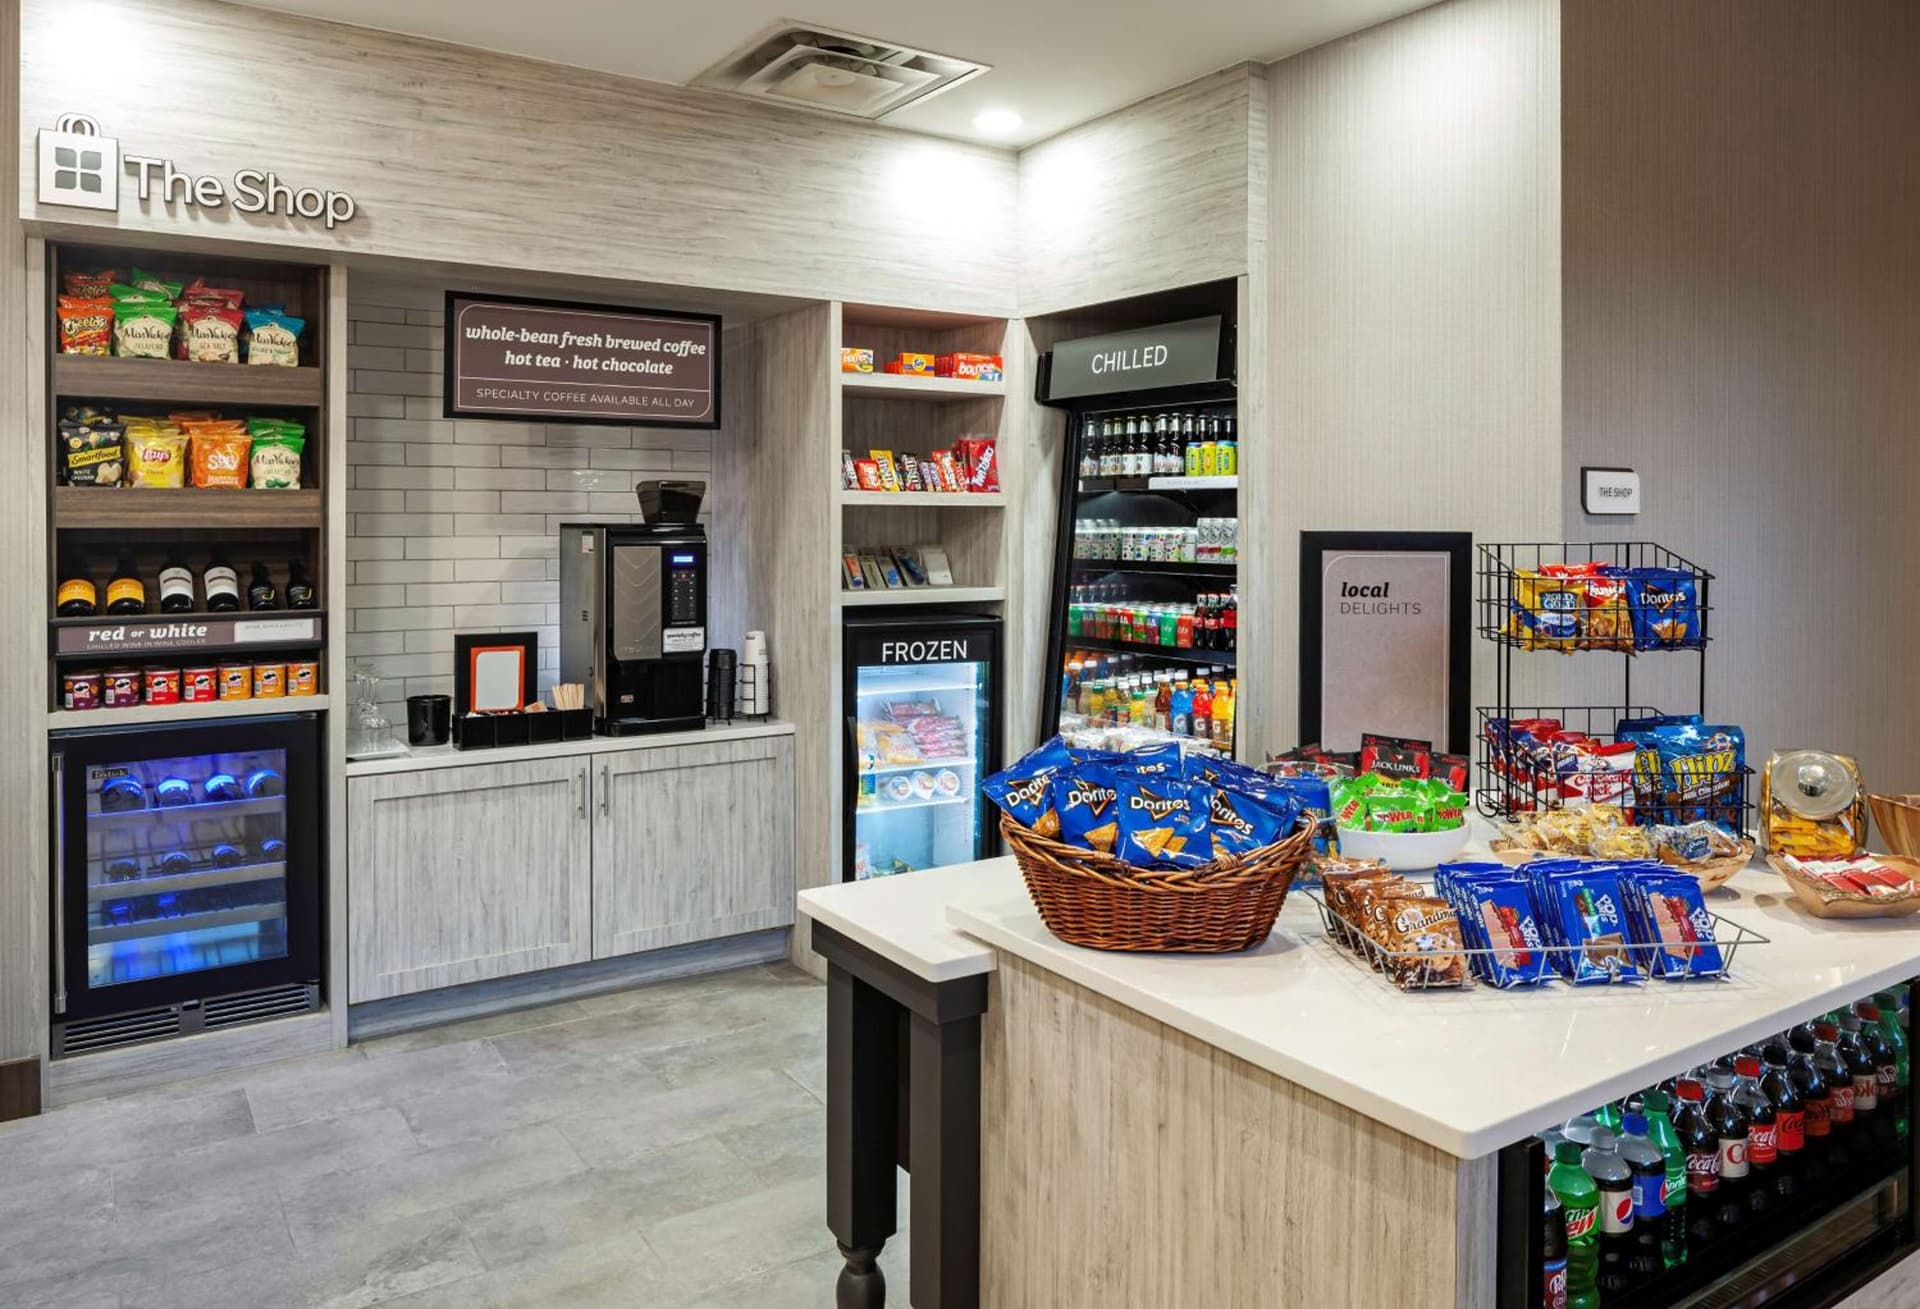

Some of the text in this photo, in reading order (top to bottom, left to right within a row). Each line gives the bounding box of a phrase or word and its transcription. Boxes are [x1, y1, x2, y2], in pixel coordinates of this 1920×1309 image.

[124, 154, 355, 228] The Shop
[465, 325, 706, 357] whole-bean fresh brewed coffee
[505, 350, 673, 374] hot tea hot chocolate
[1091, 345, 1168, 374] CHILLED
[477, 388, 694, 408] SPECIALTY COFFEE AVAILABLE ALL DAY
[72, 451, 117, 465] Smartfood
[1600, 487, 1632, 498] THE SHOP
[1341, 582, 1389, 598] local
[1640, 591, 1686, 605] Doritos
[1340, 602, 1422, 615] DELIGHTS
[89, 626, 124, 642] red
[150, 623, 208, 639] white
[882, 640, 968, 663] FROZEN
[1068, 789, 1117, 806] Dorito
[1131, 796, 1191, 811] Doritos
